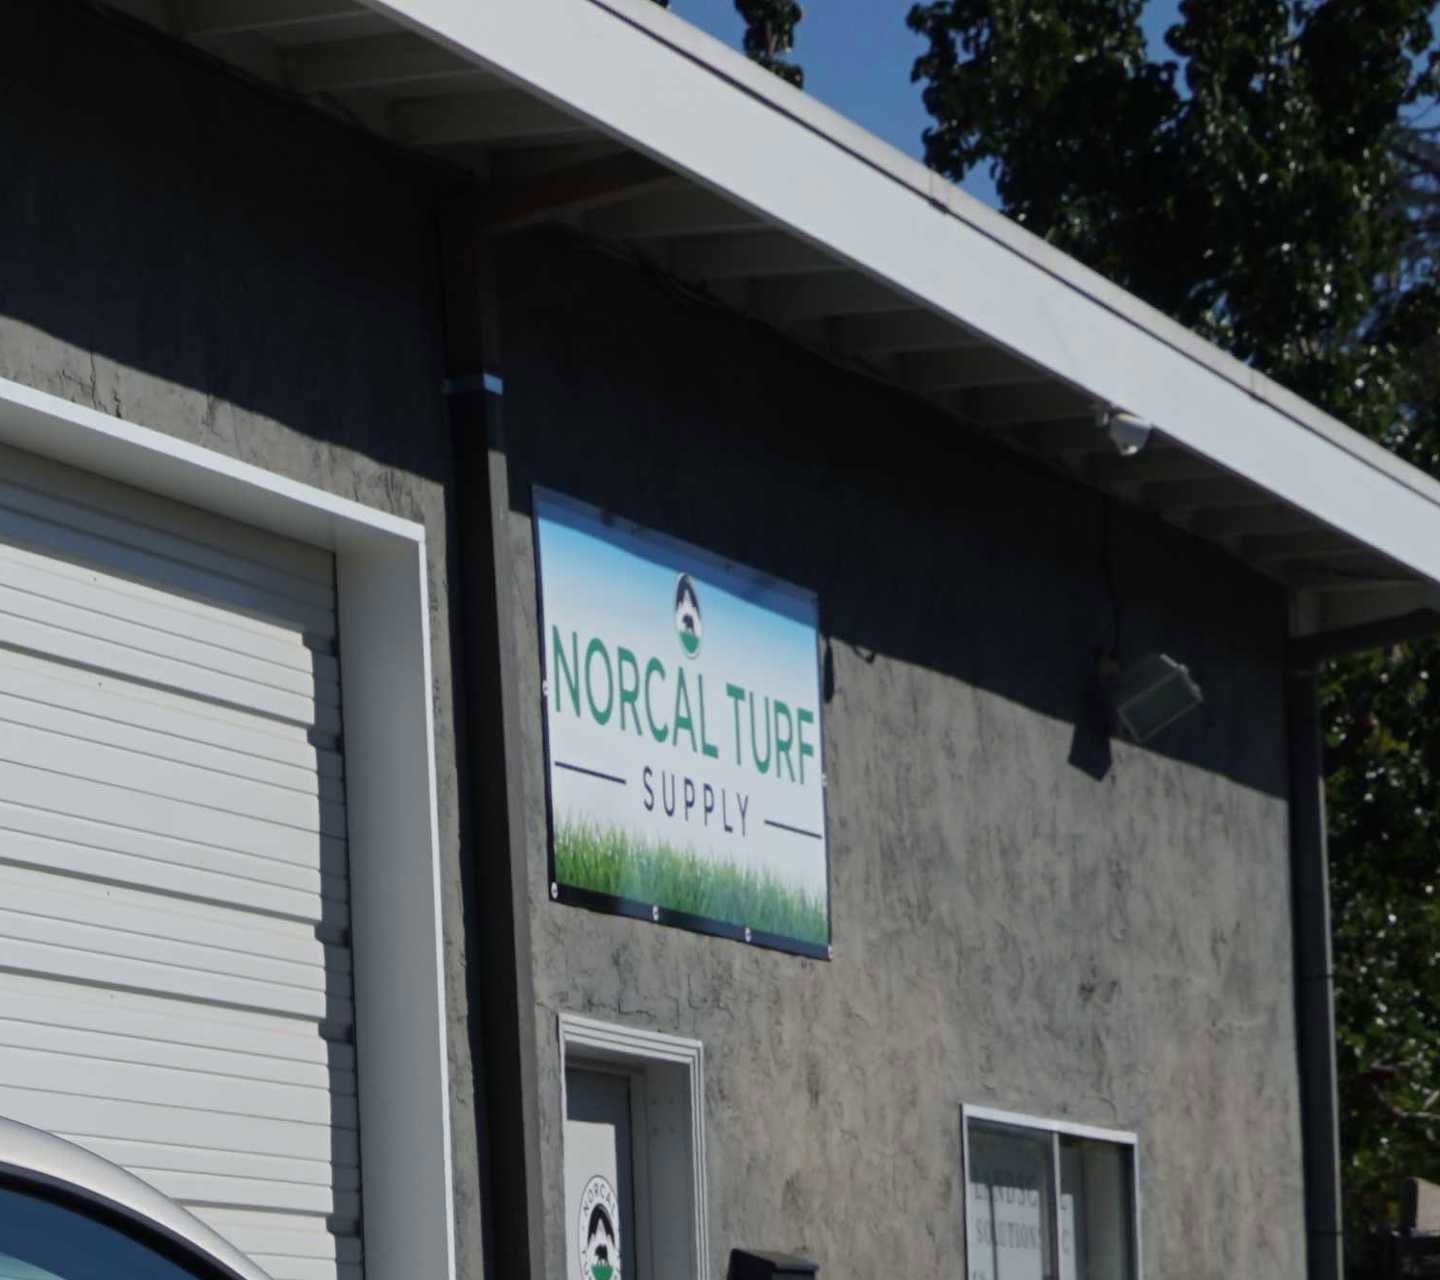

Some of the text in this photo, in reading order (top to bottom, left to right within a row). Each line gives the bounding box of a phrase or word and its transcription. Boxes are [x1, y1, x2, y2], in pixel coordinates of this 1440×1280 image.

[552, 624, 815, 785] NORCAL TURF
[642, 765, 749, 837] SUPPLY
